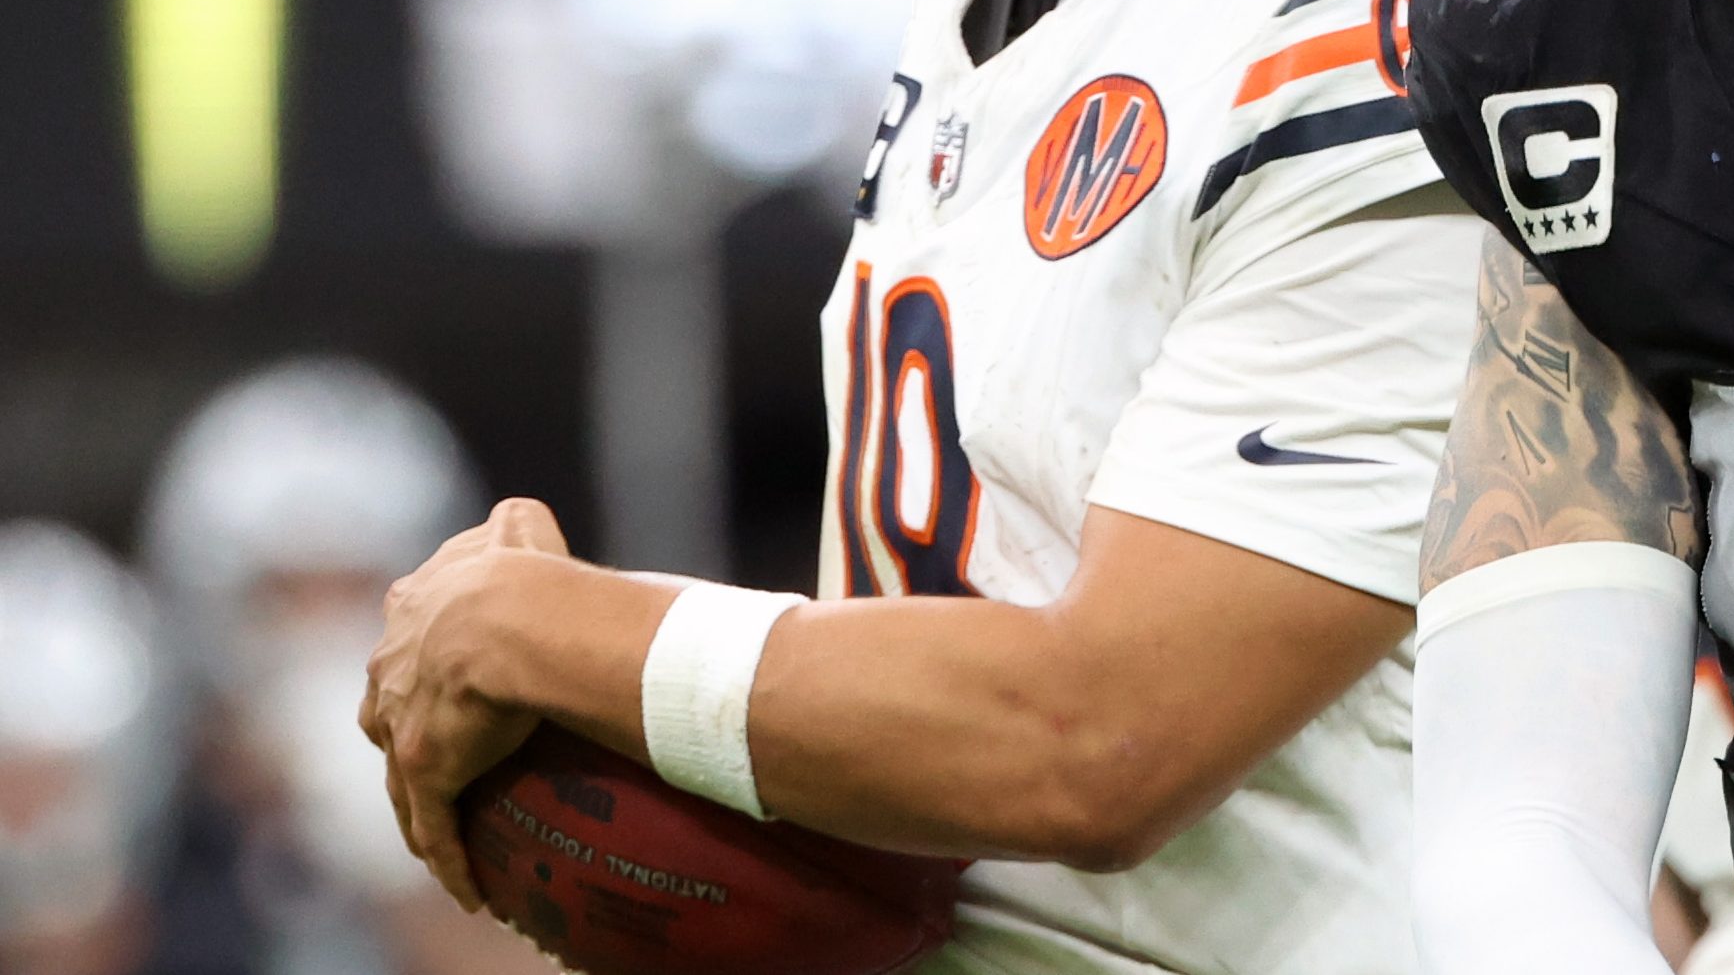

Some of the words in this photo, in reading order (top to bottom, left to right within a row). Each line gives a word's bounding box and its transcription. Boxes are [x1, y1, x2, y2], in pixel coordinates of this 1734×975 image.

[1498, 99, 1601, 209] C
[495, 796, 596, 865] FOOTBAL
[605, 854, 729, 904] NATIONAL
